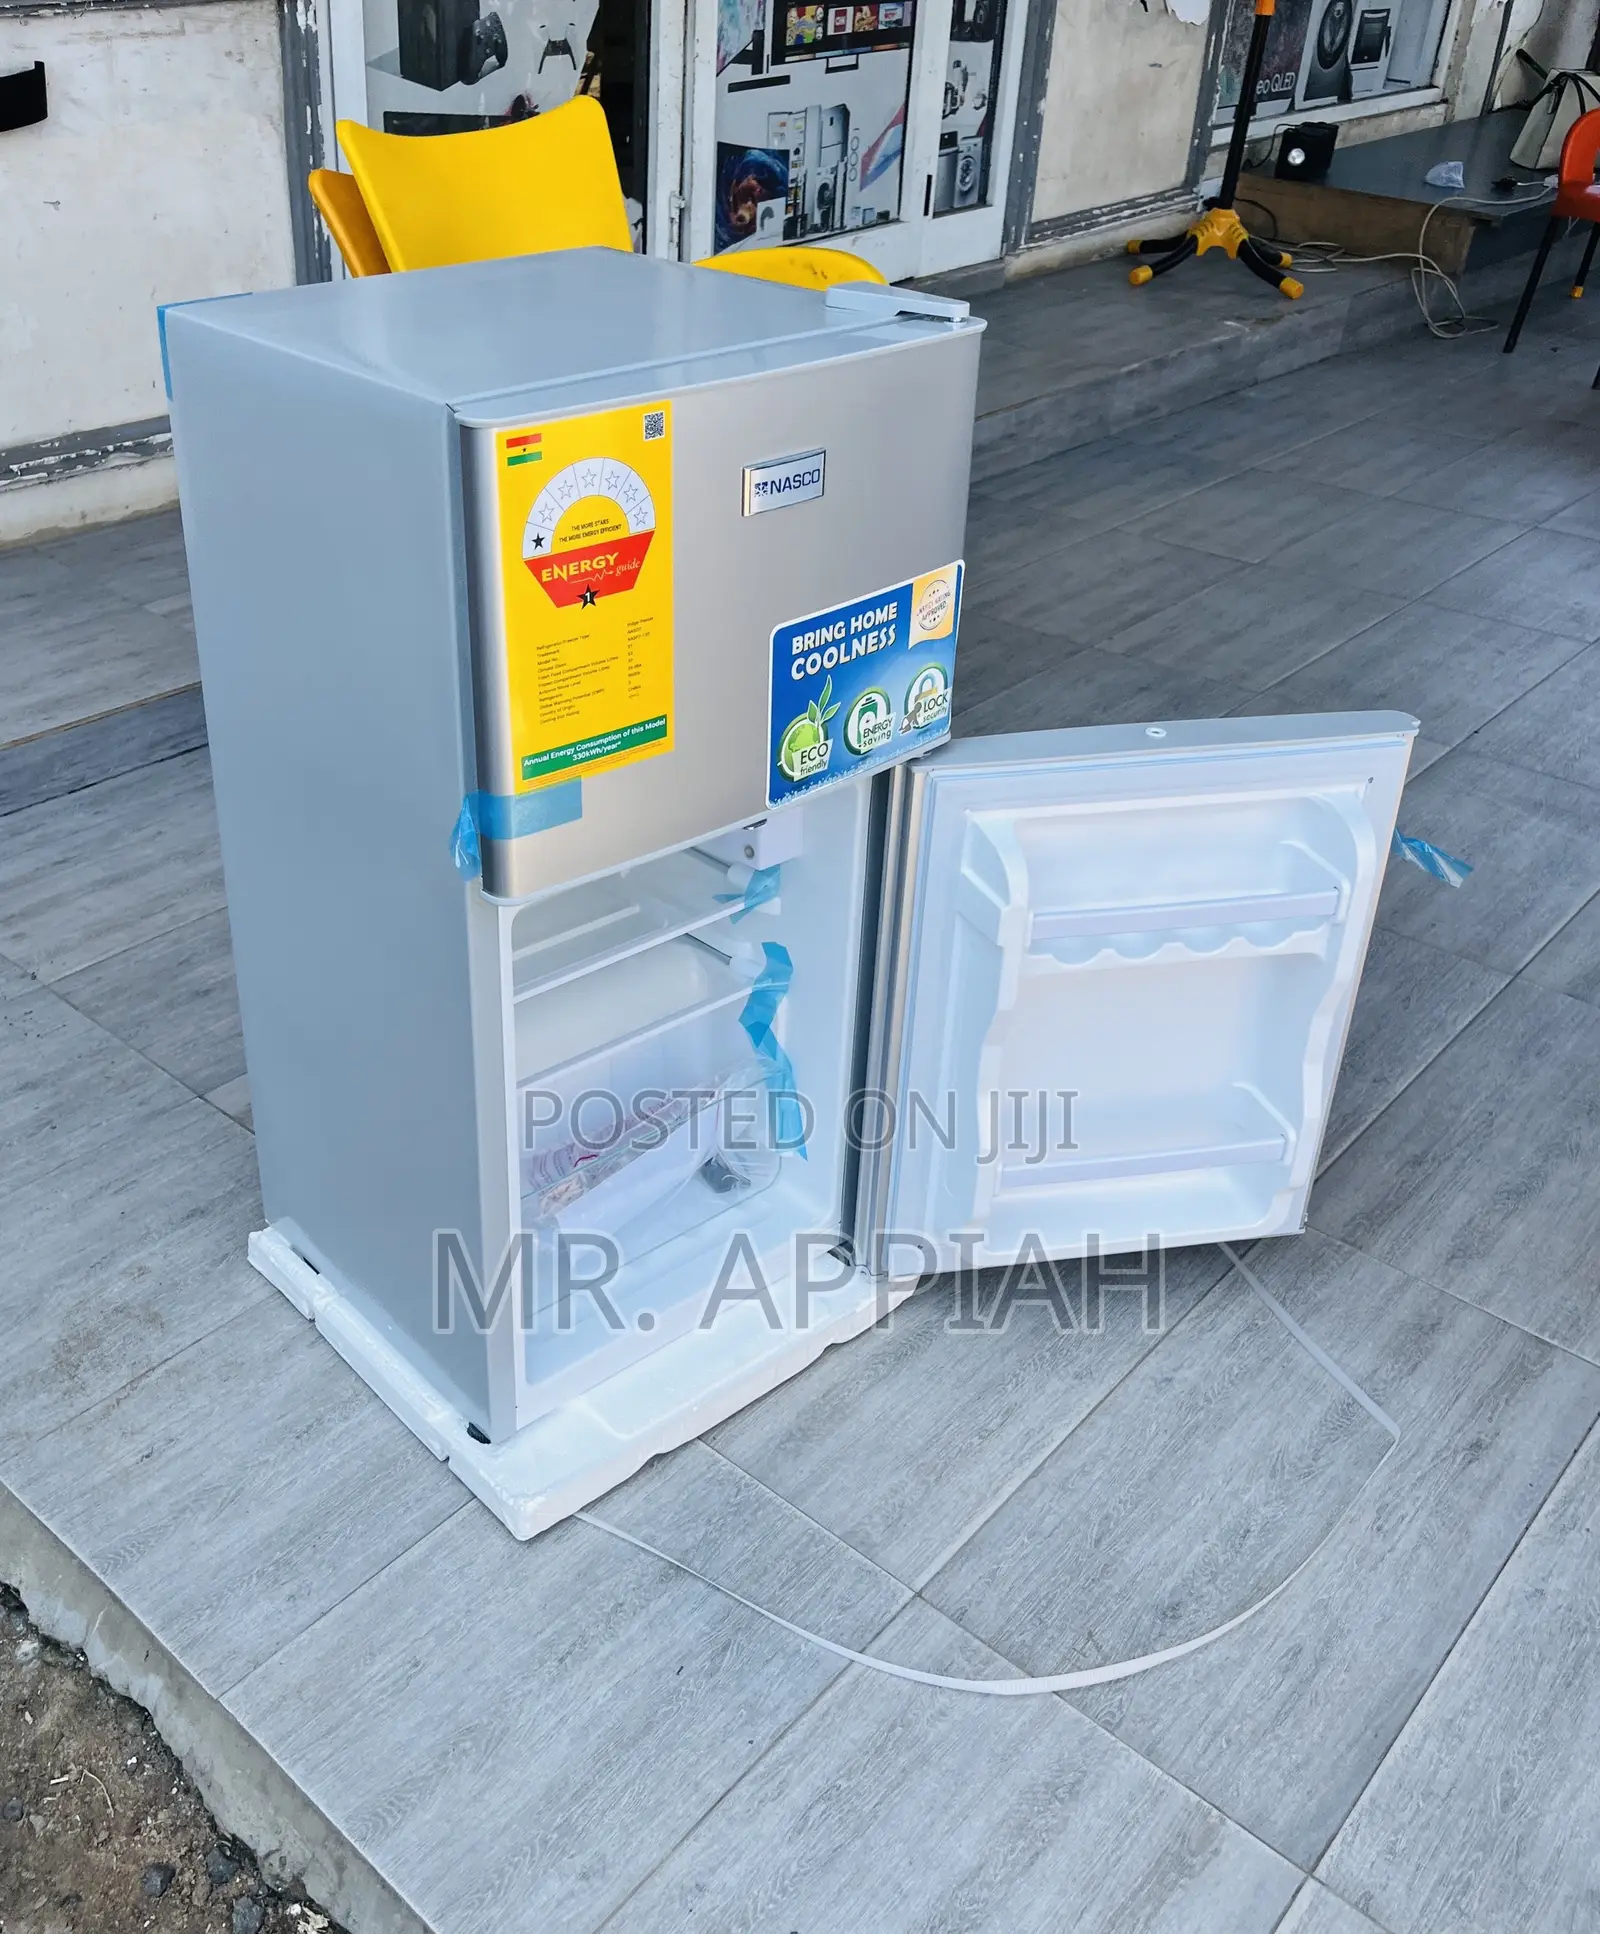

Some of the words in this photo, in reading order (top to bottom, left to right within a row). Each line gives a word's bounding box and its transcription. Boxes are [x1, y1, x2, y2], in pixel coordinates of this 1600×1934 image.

[1256, 79, 1270, 95] eo
[1271, 72, 1296, 92] QLED
[770, 468, 820, 494] NASCO
[541, 552, 619, 582] ENERGY
[615, 557, 640, 576] guide
[584, 592, 590, 602] 1
[792, 621, 846, 655] BRING
[850, 601, 898, 635] HOME
[791, 623, 896, 681] COOLNESS
[923, 692, 948, 713] LOCK
[923, 704, 947, 722] security
[863, 717, 893, 738] ENERGY
[863, 730, 892, 747] saving
[523, 753, 549, 767] Annual
[550, 746, 575, 759] Energy
[576, 732, 621, 751] Consumption
[623, 729, 630, 738] of
[631, 725, 644, 735] this
[645, 718, 666, 730] Model
[801, 743, 828, 765] ECO
[800, 759, 827, 775] friendly
